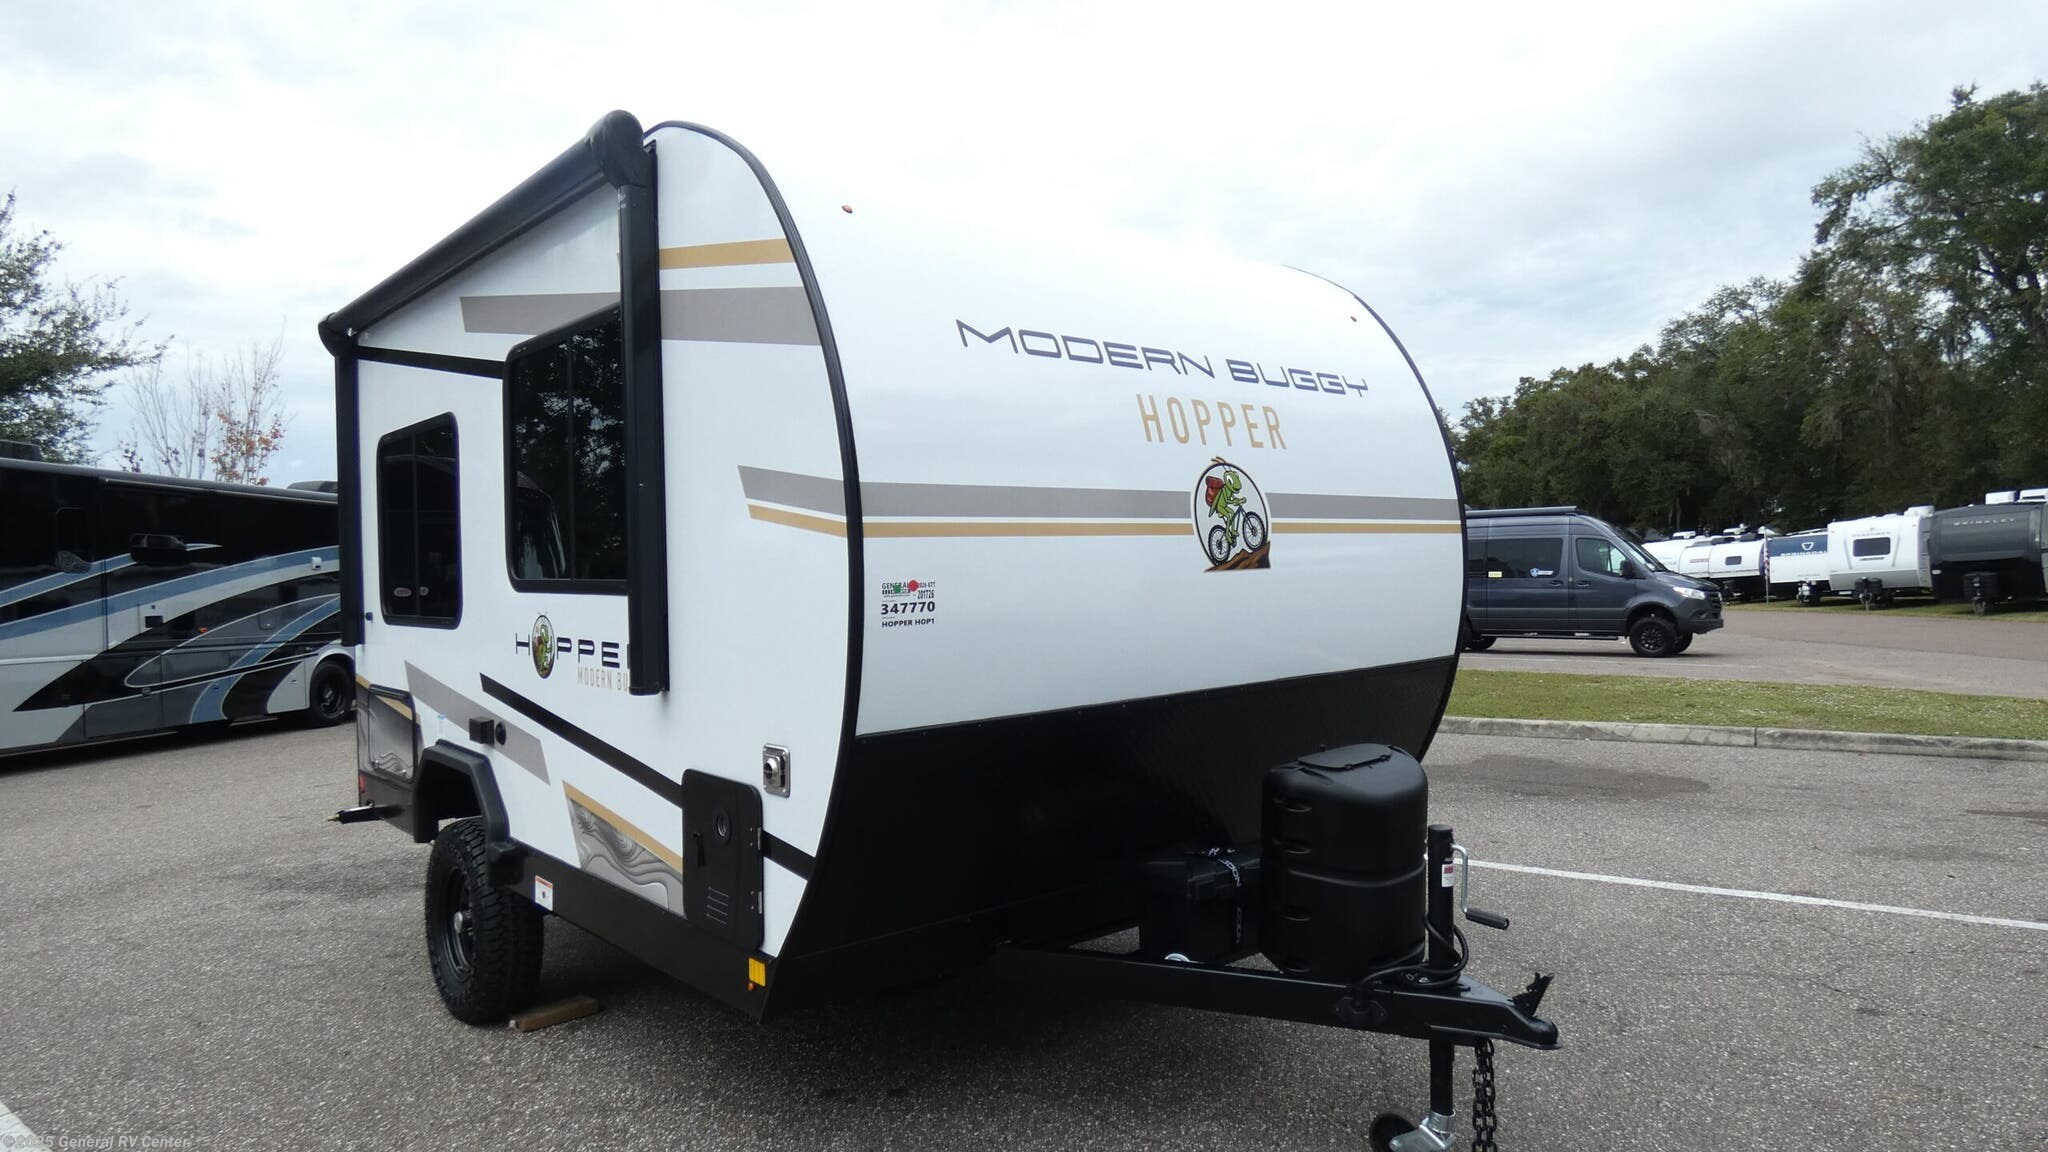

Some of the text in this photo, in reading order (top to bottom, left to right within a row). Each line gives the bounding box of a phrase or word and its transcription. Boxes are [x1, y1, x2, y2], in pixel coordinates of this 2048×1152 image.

[956, 319, 1369, 397] MODERN BUGGY
[1136, 393, 1287, 450] HOPPER
[881, 601, 936, 615] 347770
[881, 620, 913, 628] HOPPER
[577, 666, 613, 689] MODERN
